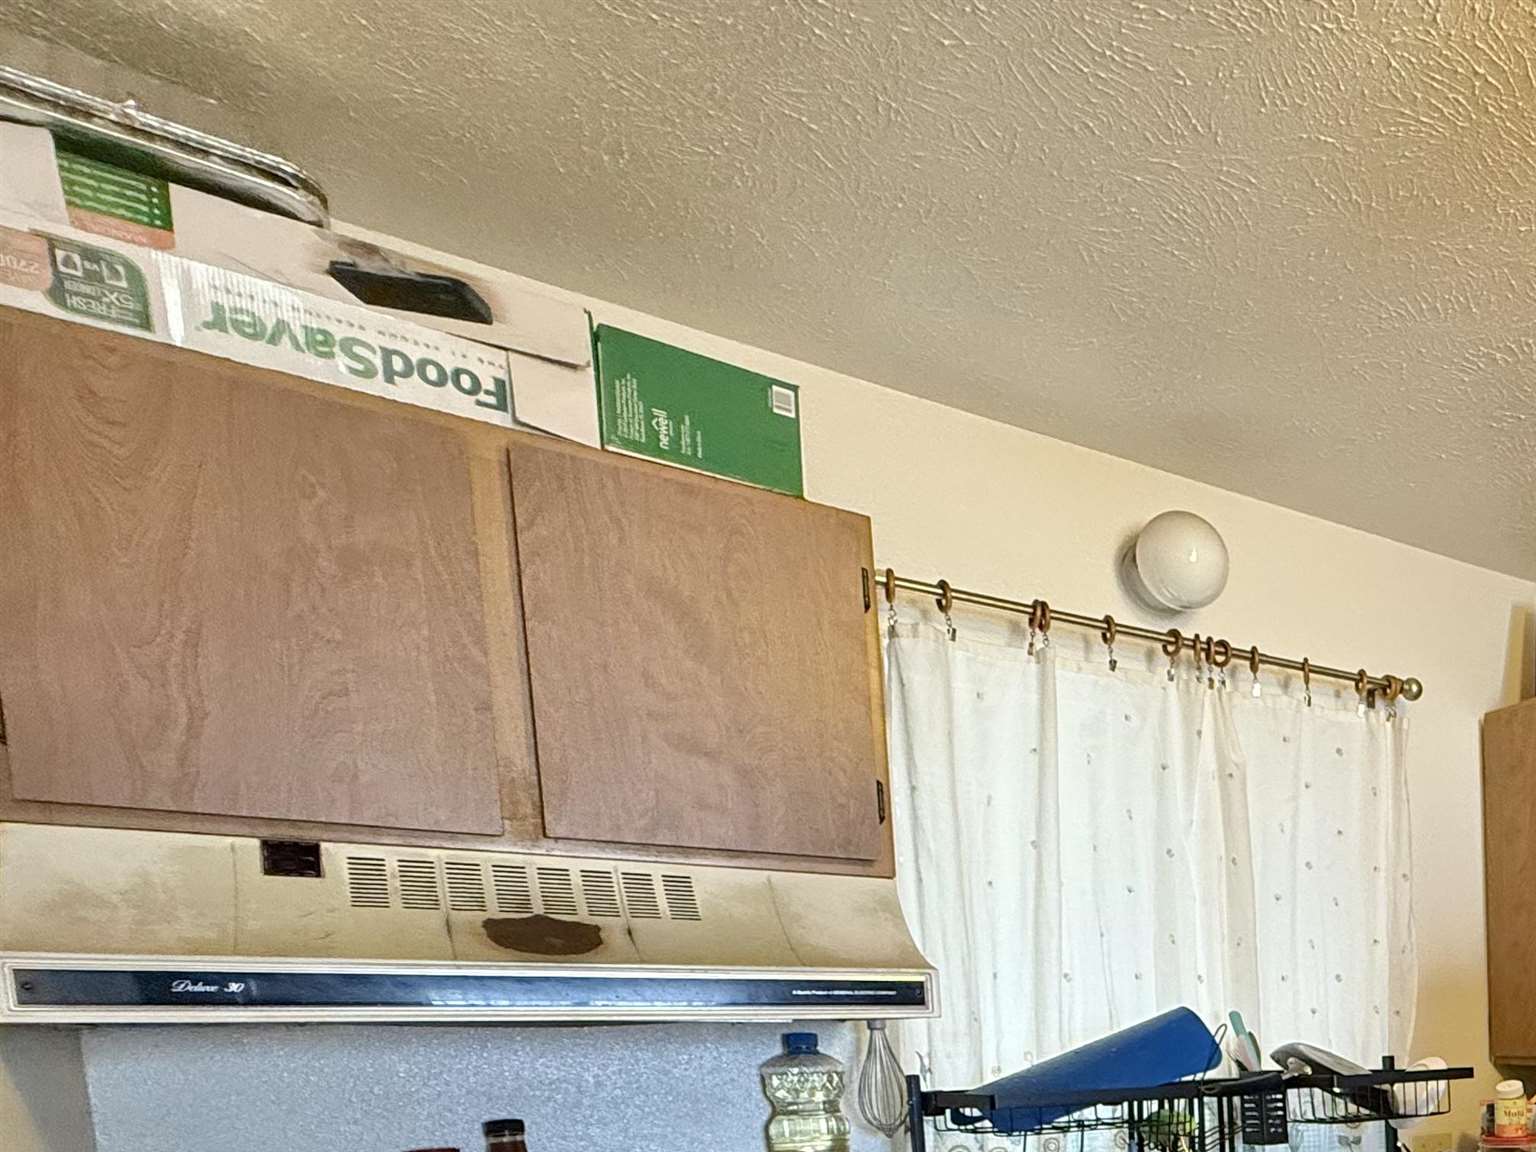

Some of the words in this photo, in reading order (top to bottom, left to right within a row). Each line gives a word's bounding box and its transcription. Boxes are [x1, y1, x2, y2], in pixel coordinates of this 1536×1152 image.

[65, 293, 118, 318] FRESH
[201, 302, 508, 413] FoodSaver
[651, 408, 670, 450] newell
[170, 979, 220, 993] Deluxe
[223, 981, 246, 993] 30
